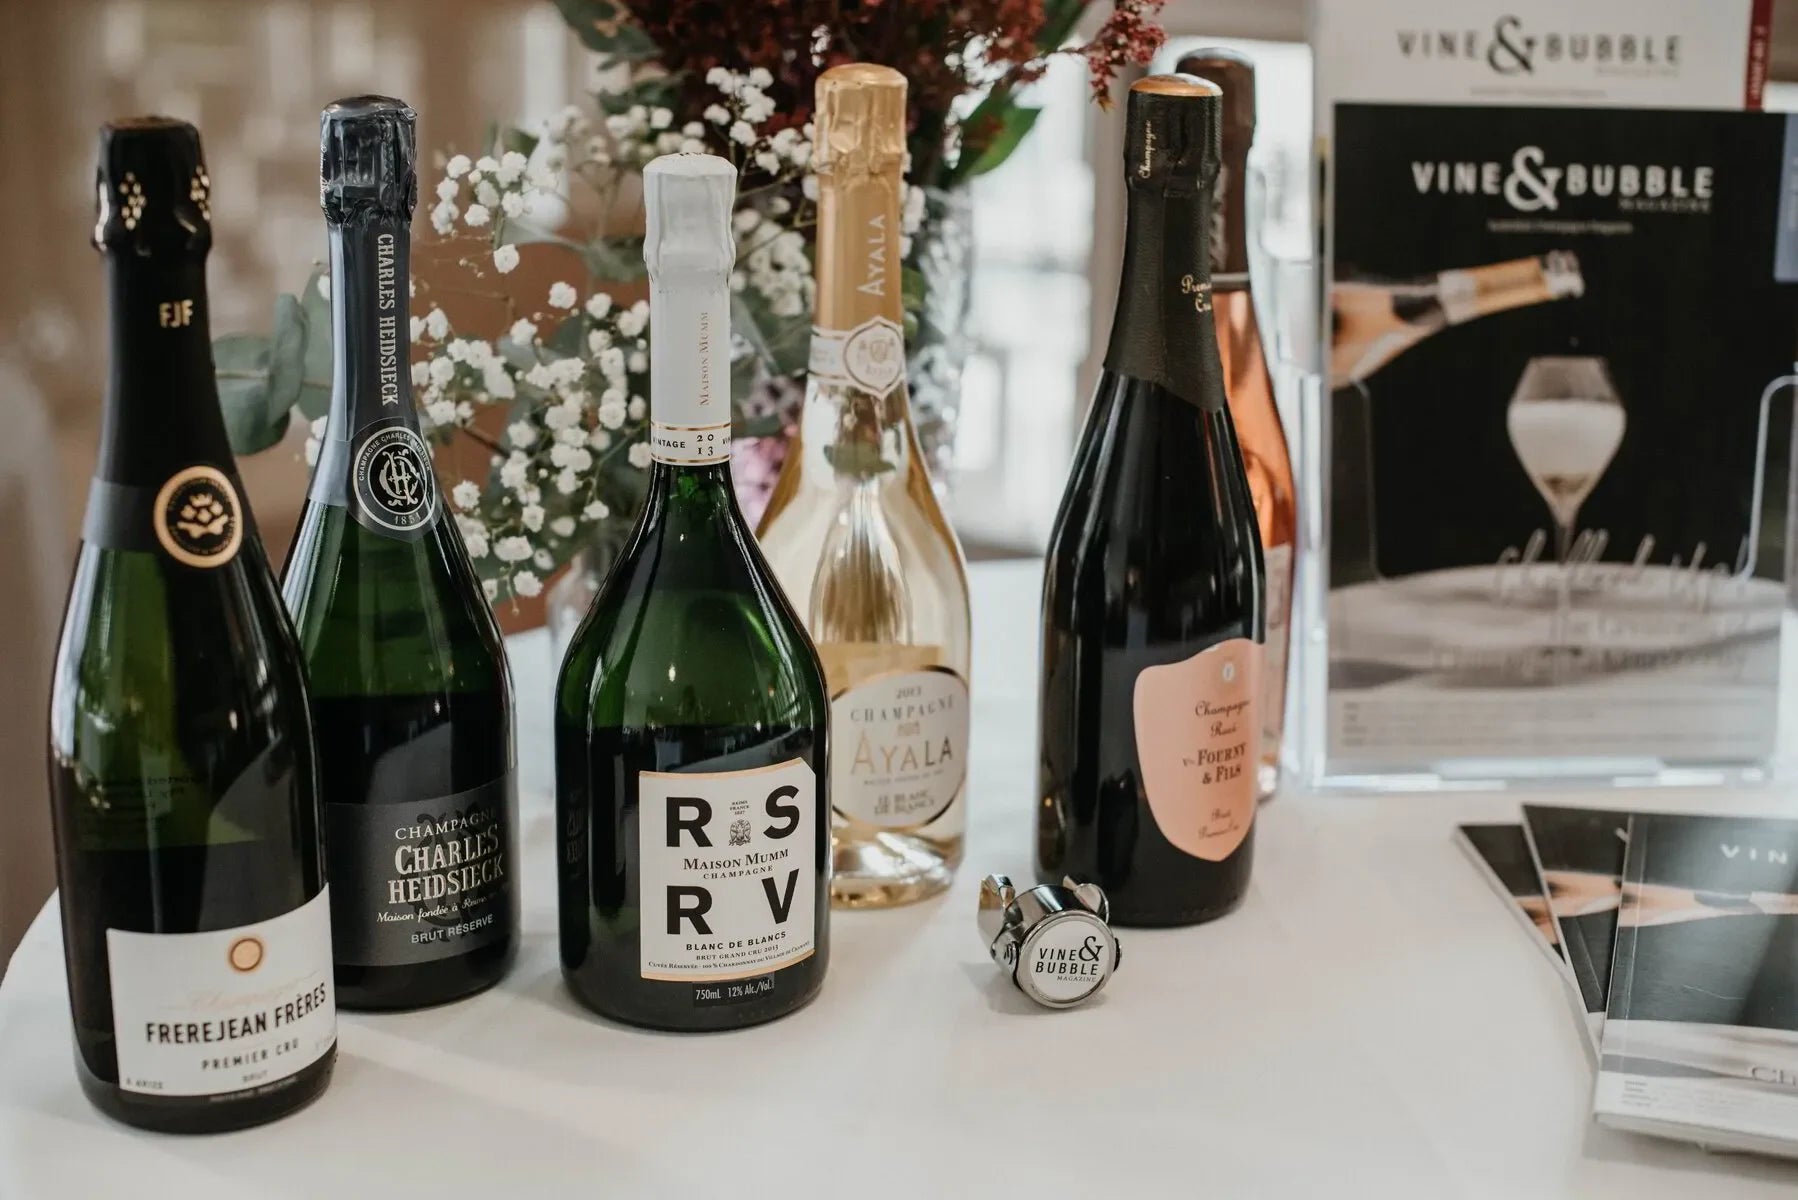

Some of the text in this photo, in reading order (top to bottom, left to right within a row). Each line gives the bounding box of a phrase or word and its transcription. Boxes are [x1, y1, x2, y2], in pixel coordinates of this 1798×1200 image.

[1396, 14, 1682, 75] VINE & BUBBLE
[1410, 145, 1714, 212] VINE & BUBBLE
[857, 214, 886, 296] AYALA
[159, 300, 193, 328] FJF
[378, 233, 399, 406] CHARLES HEIDSIECK
[699, 312, 710, 406] MAISON MUMM
[359, 440, 381, 482] CHAMPAGNE
[850, 695, 953, 722] CHAMPAGNE
[850, 729, 953, 775] AYALA
[1197, 742, 1247, 766] FOURNY
[666, 785, 800, 847] R S
[394, 823, 499, 875] CHARLES
[683, 848, 789, 870] MAISON MUMM
[387, 853, 503, 904] HEIDSIECK
[703, 865, 774, 880] CHAMPAGNE
[377, 911, 414, 923] Maison
[418, 904, 449, 923] fondée
[666, 868, 800, 935] R V
[411, 914, 494, 943] BRUT RÉSERVE
[686, 931, 786, 951] BLANC DE BLANCS
[1039, 935, 1104, 962] VINE &
[1035, 961, 1099, 976] BUBBLE
[695, 988, 722, 1000] 750mL
[727, 987, 743, 998] 12%
[146, 1012, 267, 1044] FREREJEAN
[274, 982, 327, 1028] FRÈRES
[202, 1049, 268, 1070] PREMIER
[275, 1038, 300, 1056] CRU
